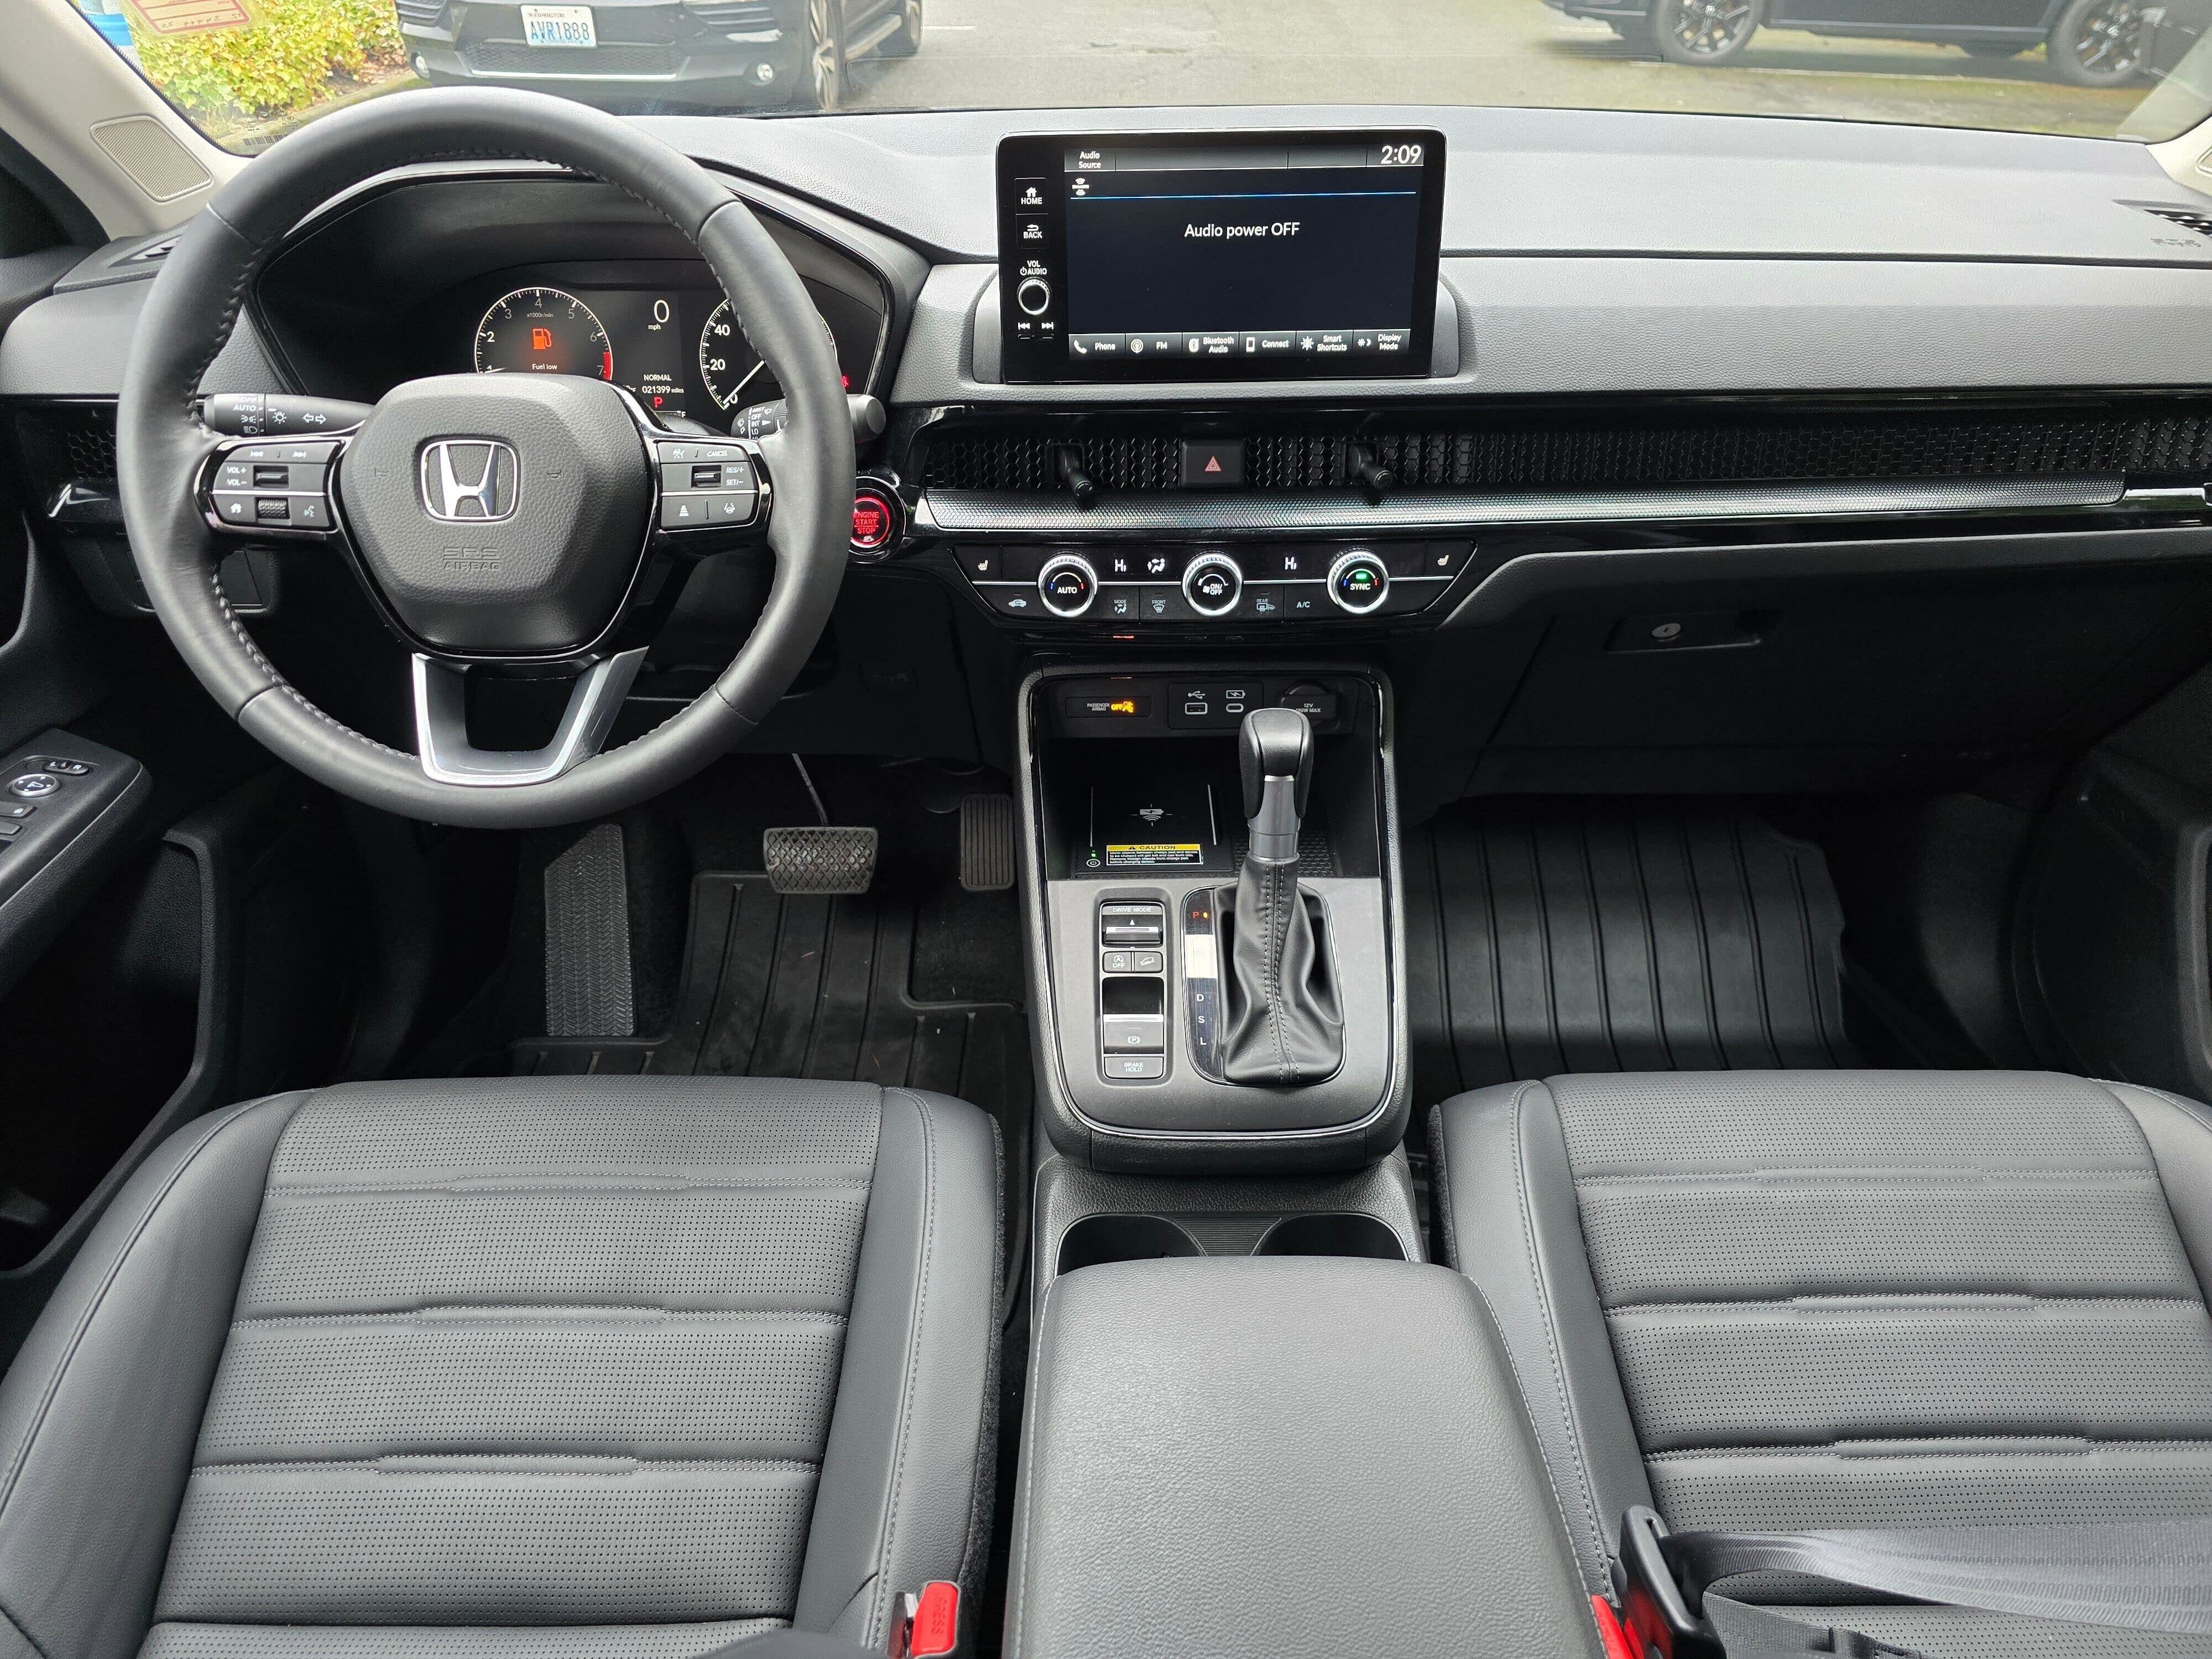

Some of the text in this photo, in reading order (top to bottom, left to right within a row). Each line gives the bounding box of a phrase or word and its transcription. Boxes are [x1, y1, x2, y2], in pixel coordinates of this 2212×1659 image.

[530, 21, 589, 40] AVR1888
[1079, 151, 1100, 159] Audio
[1380, 145, 1421, 164] 2:09
[1184, 222, 1300, 240] Audio power OFF
[535, 298, 542, 309] 4
[504, 309, 512, 319] 3
[568, 309, 575, 319] 5
[654, 300, 670, 323] 0
[714, 324, 730, 336] 40
[487, 331, 495, 342] 2
[590, 332, 597, 342] 6
[1203, 336, 1234, 345] Bluetooth
[1378, 333, 1401, 343] Display
[1094, 342, 1115, 351] Phone
[1156, 341, 1167, 350] FM
[1209, 345, 1228, 353] Audio
[1261, 340, 1289, 348] Connect
[1317, 342, 1347, 352] Shortcuts
[1379, 342, 1398, 350] Mode
[710, 358, 726, 371] 20
[597, 365, 603, 375] 7
[641, 385, 671, 394] 021399
[654, 397, 663, 408] P
[443, 547, 499, 558] SRS
[443, 561, 500, 571] AIRBAG
[1198, 1015, 1205, 1024] S
[1199, 1037, 1207, 1045] L
